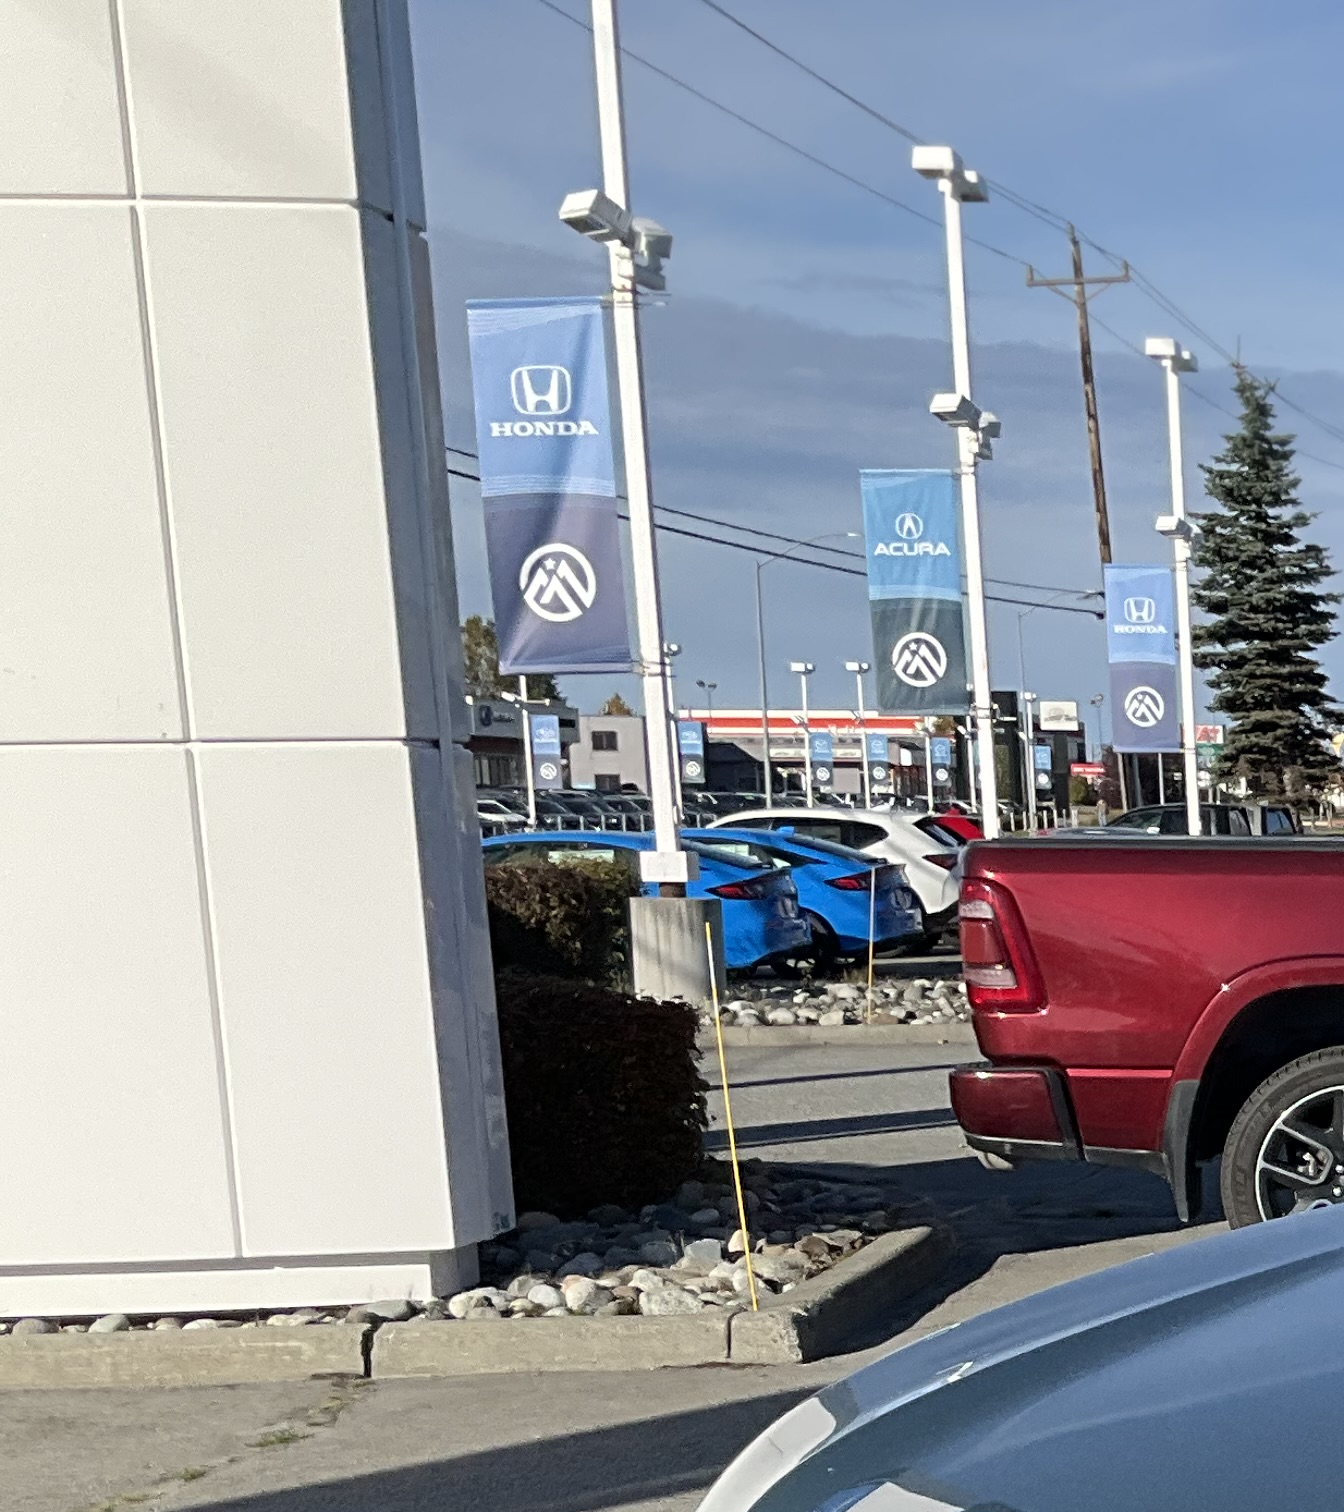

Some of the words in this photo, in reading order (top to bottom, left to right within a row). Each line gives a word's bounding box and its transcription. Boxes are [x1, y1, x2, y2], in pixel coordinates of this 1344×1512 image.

[490, 421, 599, 437] HONDA
[874, 542, 951, 556] ACURA
[1113, 625, 1168, 634] HONDA
